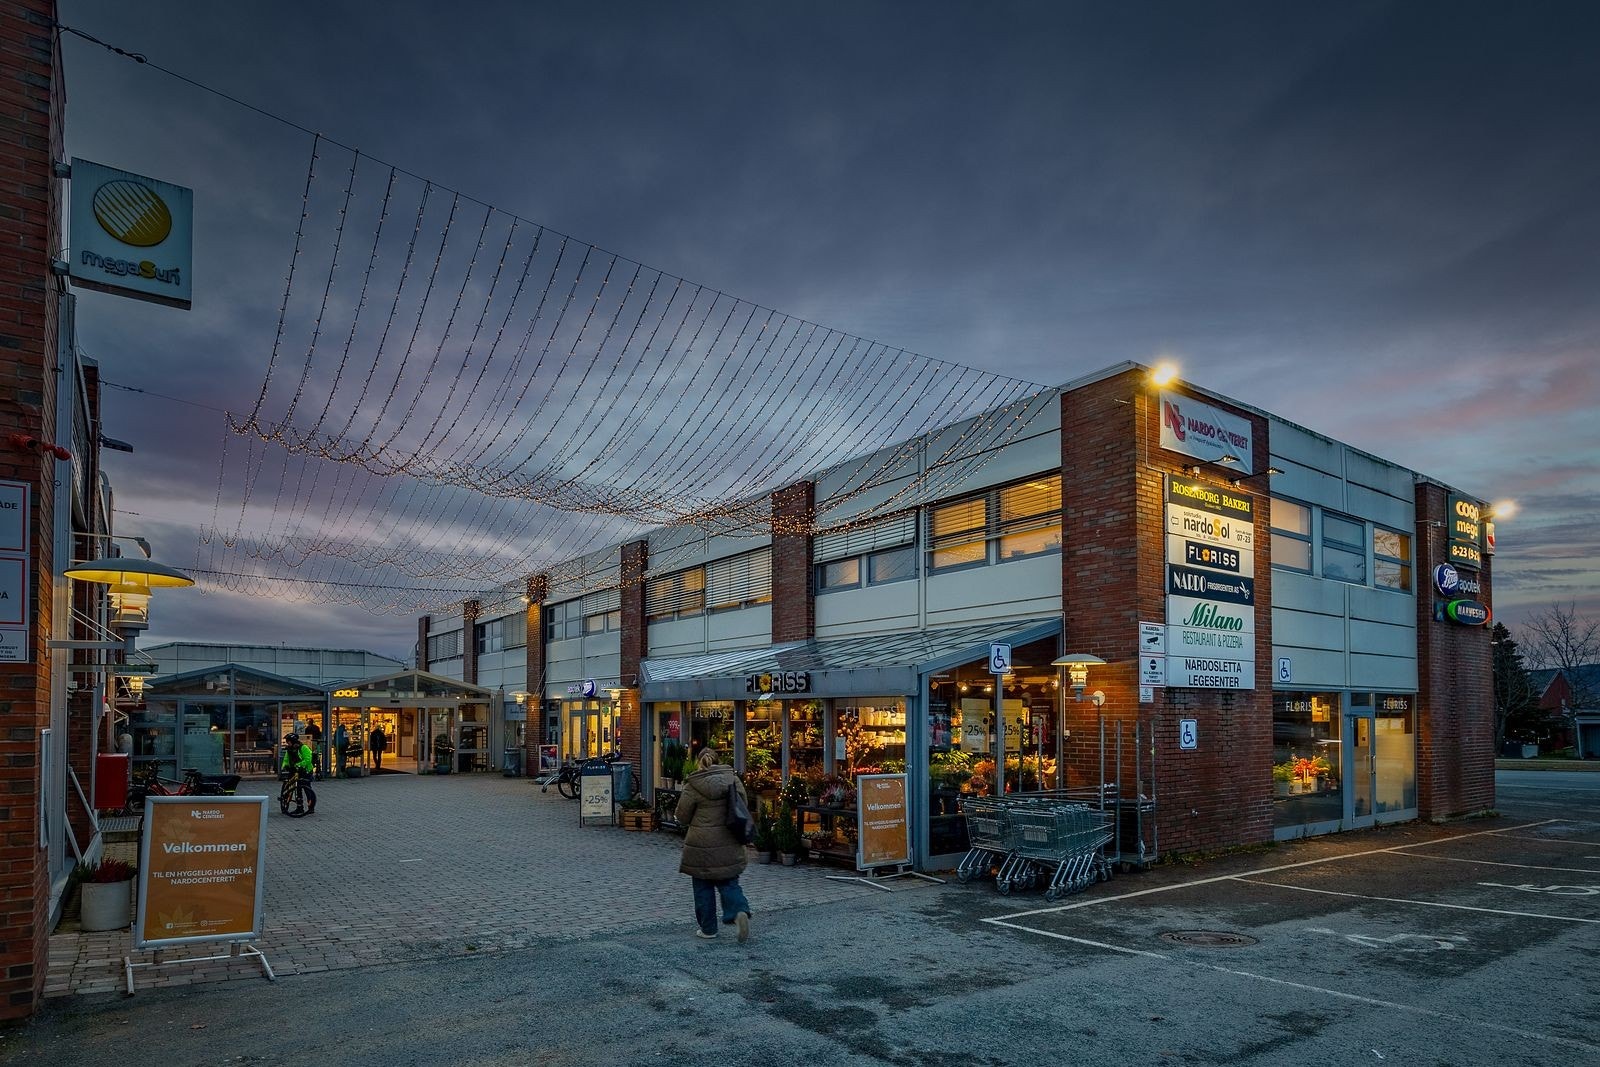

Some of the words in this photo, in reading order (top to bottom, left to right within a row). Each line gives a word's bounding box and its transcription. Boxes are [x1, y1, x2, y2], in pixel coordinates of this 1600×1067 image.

[81, 250, 181, 287] megaSun
[1187, 416, 1216, 439] NARDO
[1172, 481, 1220, 504] ROSENBORG
[1222, 494, 1250, 513] BAKERI
[1456, 501, 1479, 523] coop
[1183, 517, 1230, 540] nardoSol
[1456, 520, 1478, 540] mega
[1188, 545, 1237, 567] FLORISS
[1452, 545, 1467, 558] 8-23
[1173, 571, 1207, 593] NARDO
[1459, 579, 1481, 594] apotek
[1183, 602, 1243, 631] Milano
[1457, 605, 1486, 619] NARVESEN
[1183, 630, 1217, 647] RESTAURANT
[1218, 634, 1222, 647] &
[1223, 634, 1243, 649] PIZZERIA
[1185, 658, 1242, 673] NARDOSLETTA
[1188, 674, 1240, 688] LEGESENTER
[866, 803, 902, 812] Velkommen
[163, 842, 247, 854] Velkommen
[176, 869, 212, 877] HYGGELIG
[213, 868, 242, 876] HANDEL
[243, 866, 253, 874] PÅ
